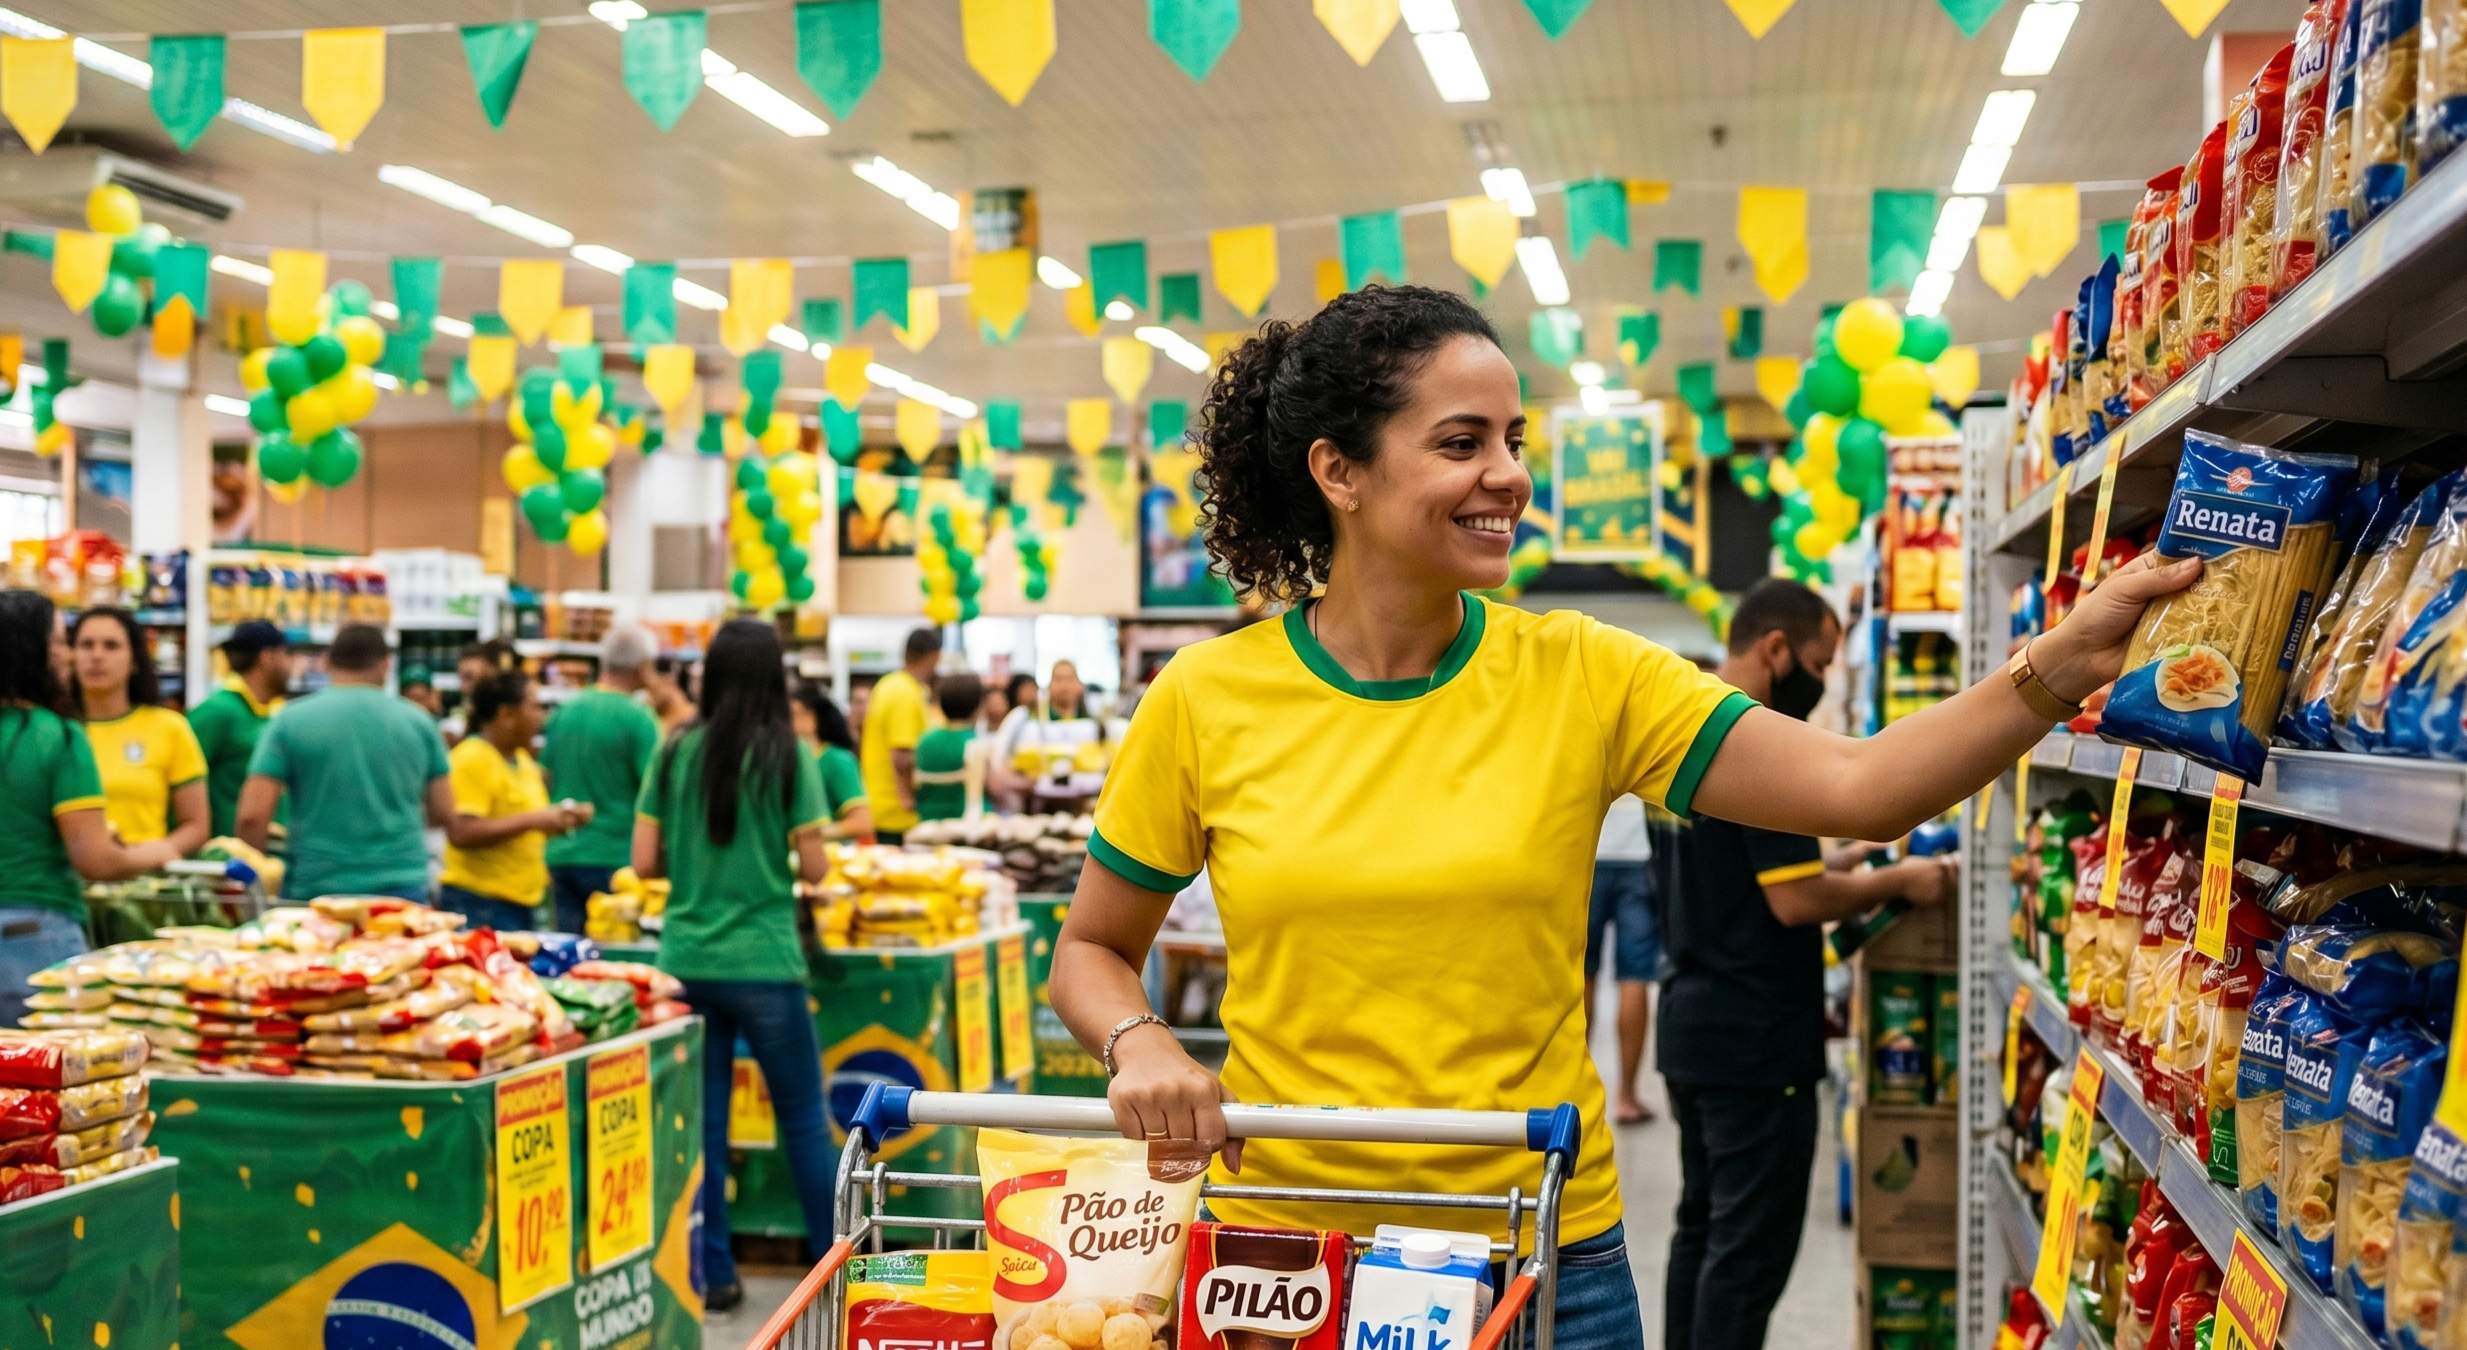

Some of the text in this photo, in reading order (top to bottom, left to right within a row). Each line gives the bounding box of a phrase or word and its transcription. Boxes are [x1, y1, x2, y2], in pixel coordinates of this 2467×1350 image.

[2175, 499, 2276, 543] Renata
[601, 1095, 637, 1135] COPA
[512, 1121, 553, 1164] COPA
[1060, 1190, 1164, 1225] Pão de
[1068, 1216, 1182, 1261] Queijo
[574, 1269, 632, 1320] COPA
[1204, 1277, 1323, 1321] PILÃO
[2226, 1253, 2277, 1348] PROMOÇÃO
[579, 1292, 655, 1350] MUNDO
